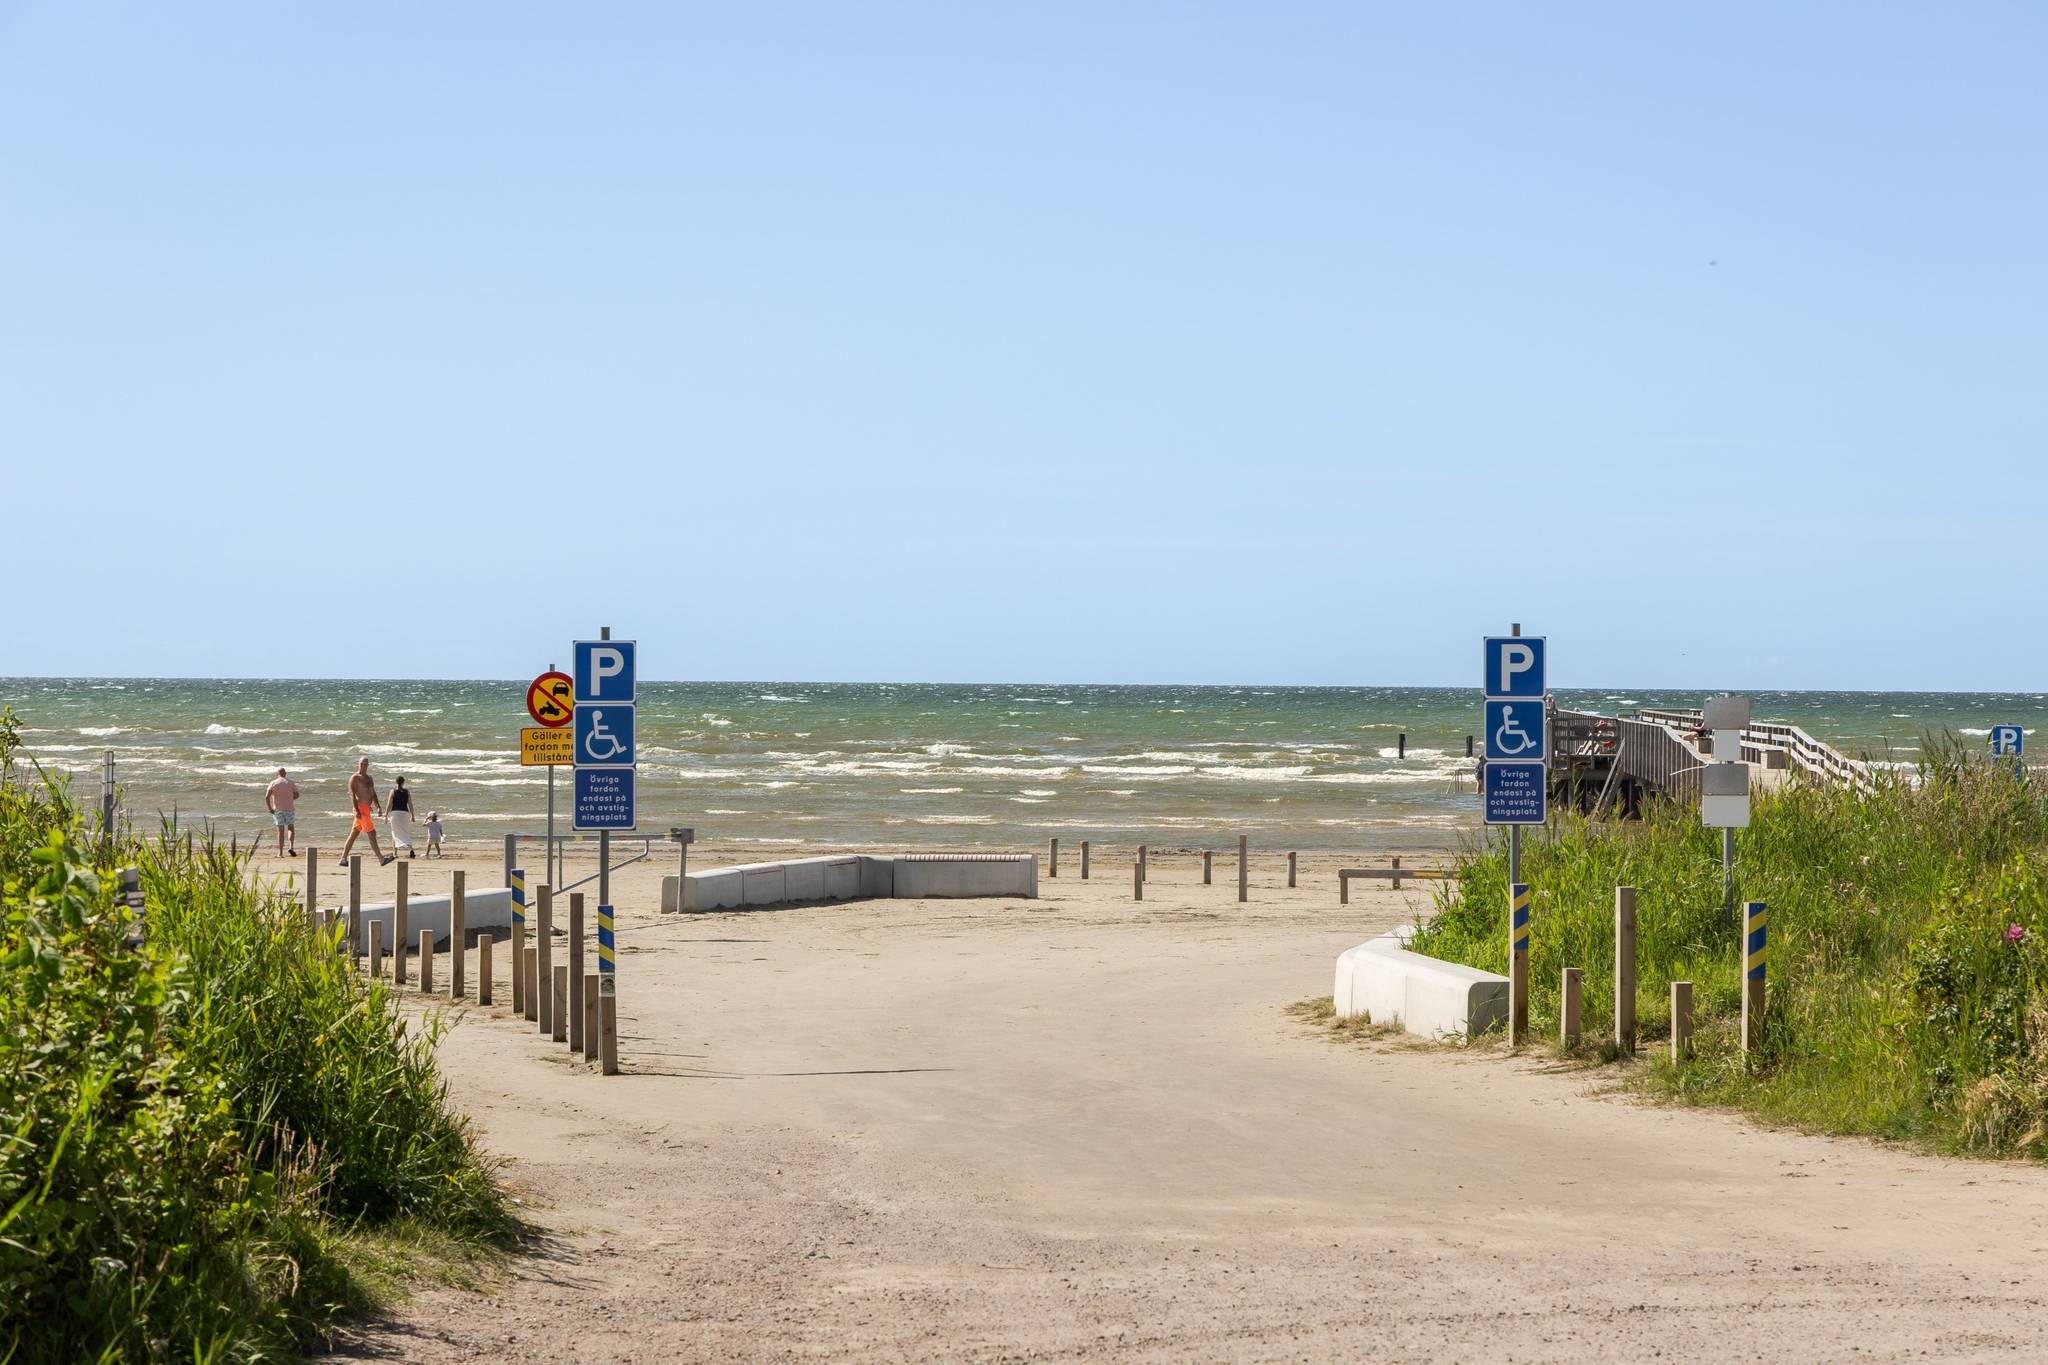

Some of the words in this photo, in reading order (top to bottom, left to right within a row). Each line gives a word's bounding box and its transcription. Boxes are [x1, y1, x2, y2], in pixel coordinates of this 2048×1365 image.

[590, 647, 625, 696] P
[1501, 643, 1535, 692] P
[532, 731, 562, 740] Gäller
[2000, 728, 2017, 754] P
[524, 742, 558, 751] fordon
[1500, 769, 1530, 779] Övriga
[590, 774, 620, 784] Övriga
[1493, 789, 1523, 797] endast
[1525, 789, 1537, 798] på
[615, 795, 626, 804] på
[1508, 799, 1540, 807] avstig-
[597, 804, 629, 813] avstig-
[1492, 808, 1537, 816] ningsplats
[581, 813, 628, 822] ningsplats
